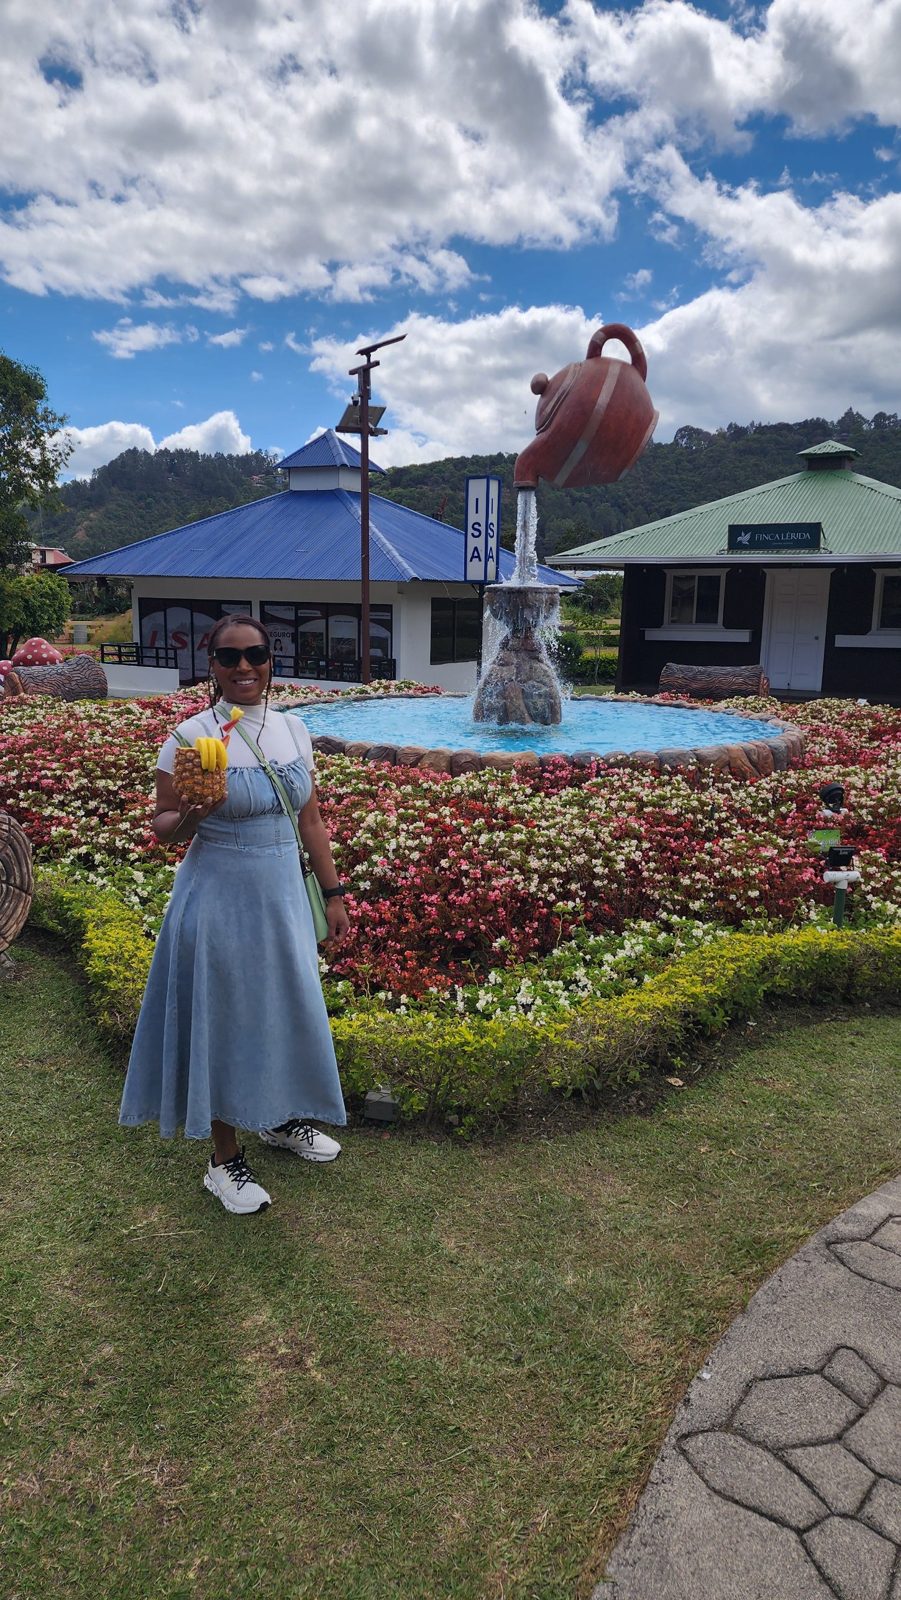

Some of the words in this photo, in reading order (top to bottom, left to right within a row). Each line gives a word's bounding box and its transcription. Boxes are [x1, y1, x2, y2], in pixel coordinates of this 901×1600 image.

[470, 497, 482, 562] ISA
[755, 533, 780, 541] FINCA
[781, 531, 812, 541] LÉRIDA
